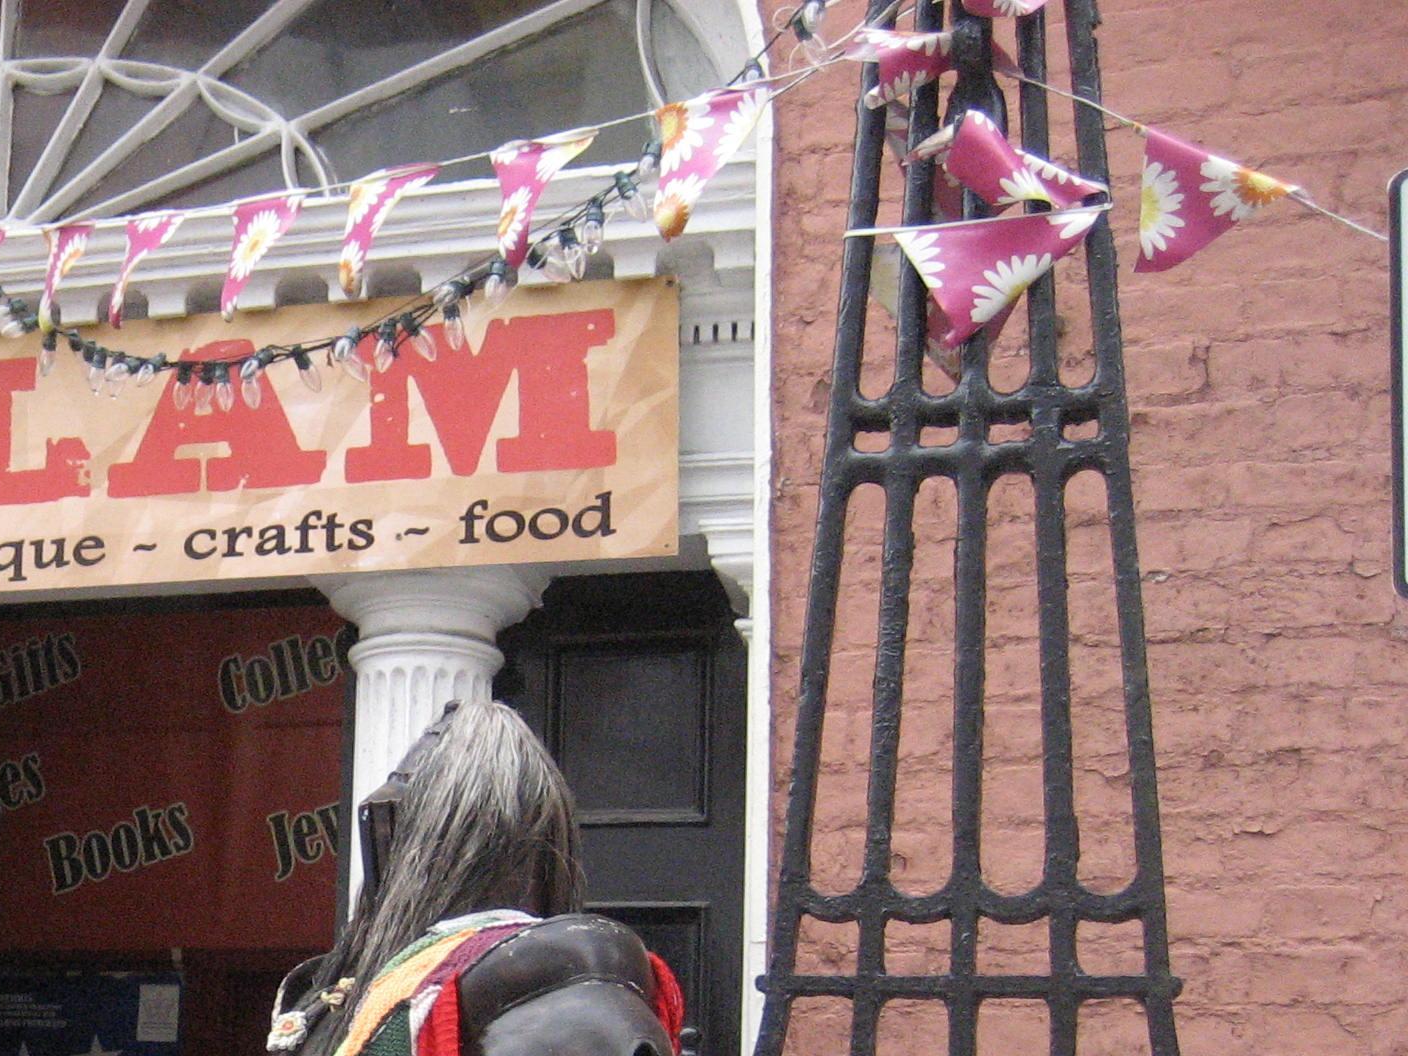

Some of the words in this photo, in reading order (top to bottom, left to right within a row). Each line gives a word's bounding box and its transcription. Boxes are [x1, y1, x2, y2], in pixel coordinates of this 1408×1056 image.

[182, 509, 376, 561] crafts
[458, 490, 618, 545] food
[43, 801, 193, 897] Books
